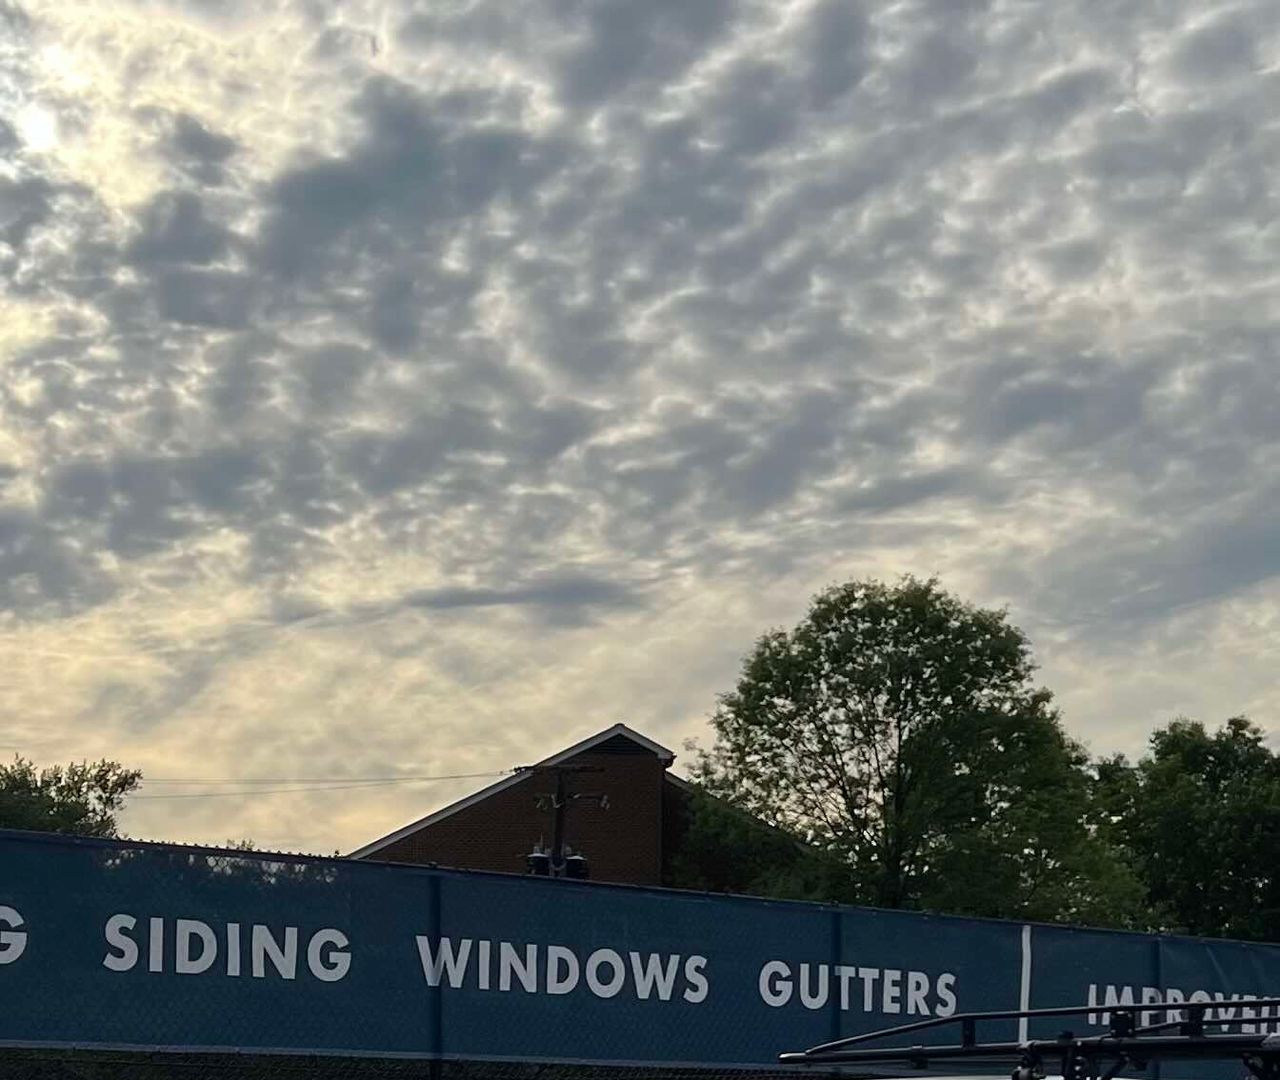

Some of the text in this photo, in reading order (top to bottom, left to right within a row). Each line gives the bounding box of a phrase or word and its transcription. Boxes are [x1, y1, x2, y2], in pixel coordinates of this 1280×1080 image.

[103, 914, 351, 982] SIDING
[416, 935, 709, 1003] WINDOWS
[759, 959, 959, 1019] GUTTERS
